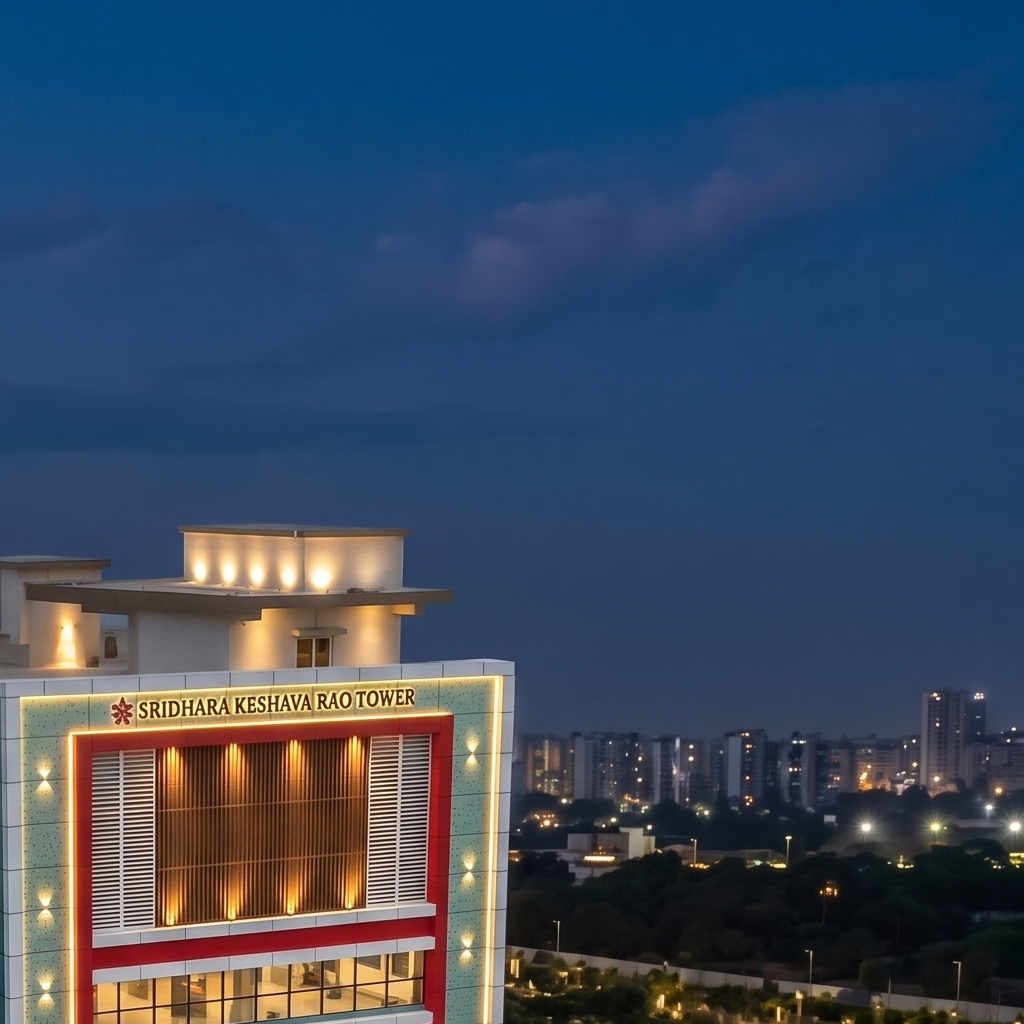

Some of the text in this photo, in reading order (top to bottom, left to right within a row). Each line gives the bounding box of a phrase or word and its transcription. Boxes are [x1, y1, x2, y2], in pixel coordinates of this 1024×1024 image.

[139, 688, 415, 719] SRIDHARA KESHAVA RAO TOWER
